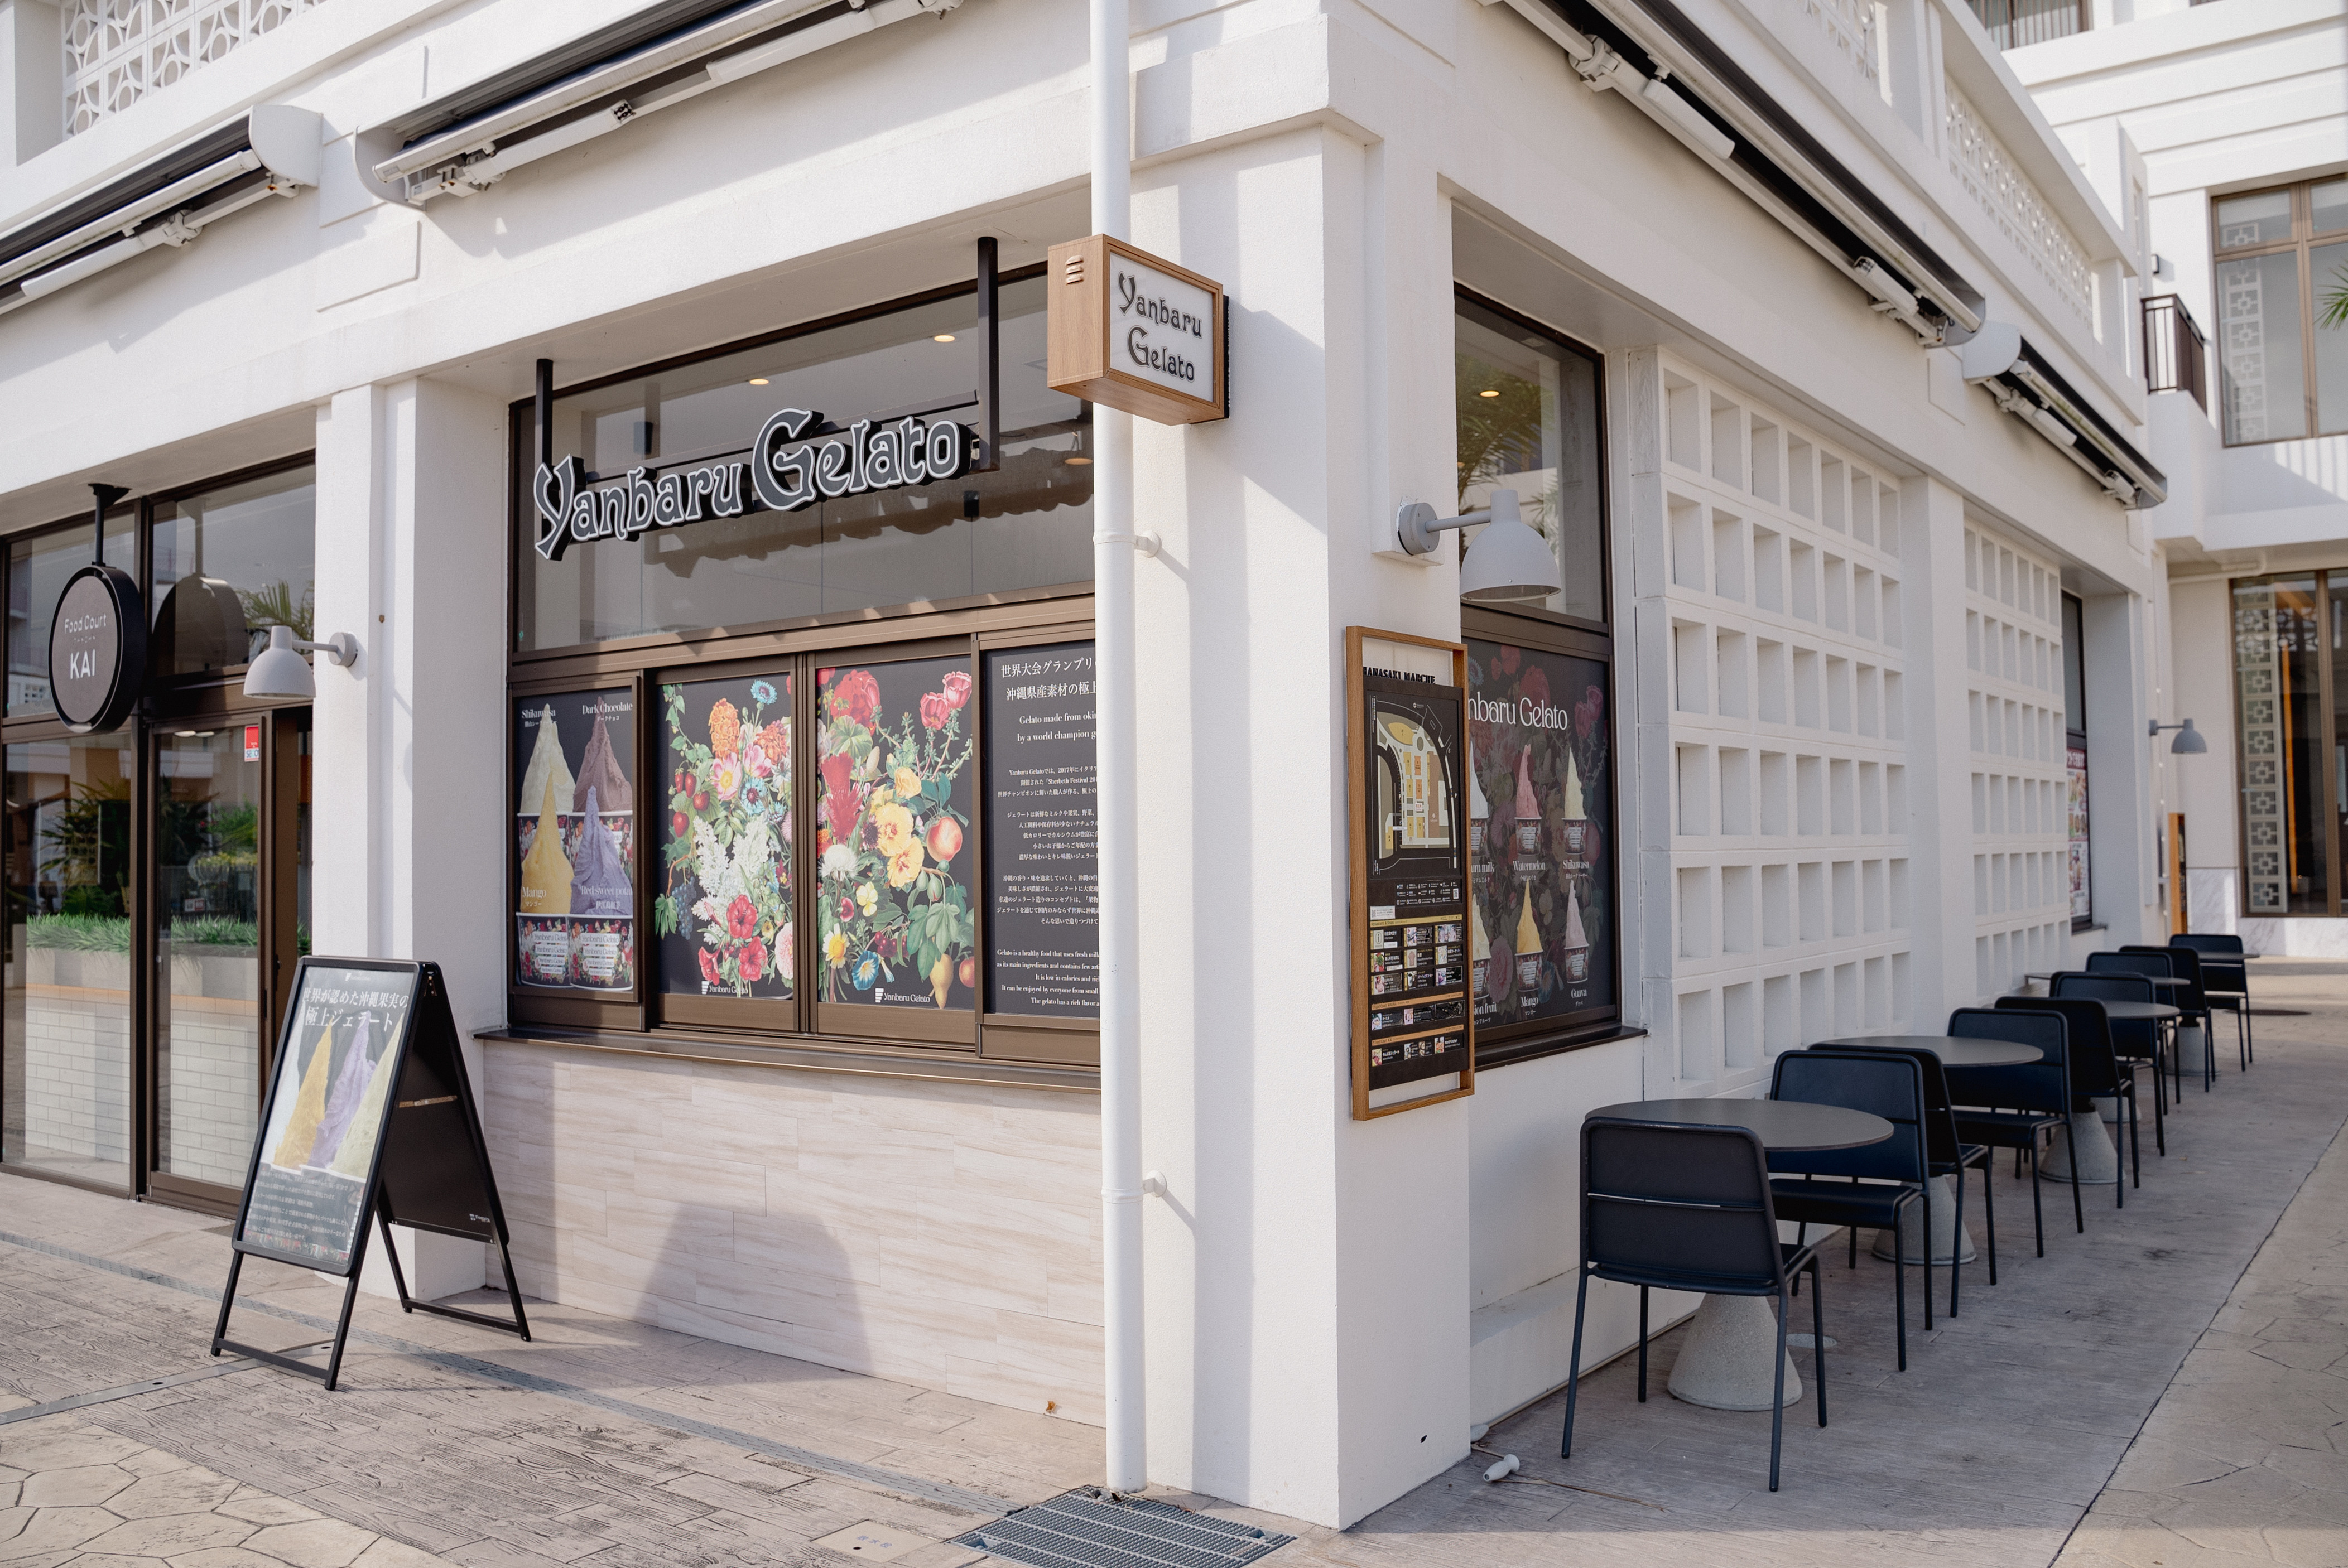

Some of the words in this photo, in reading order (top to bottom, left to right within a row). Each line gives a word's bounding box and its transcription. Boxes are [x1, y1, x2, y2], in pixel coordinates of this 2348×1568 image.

[1118, 271, 1202, 338] Yanbaru
[1127, 325, 1195, 382] Gelato
[533, 453, 744, 561] Yanbaru
[752, 407, 961, 511] Gelato
[65, 617, 83, 634] Food
[85, 614, 107, 630] Court
[70, 649, 95, 679] KAI
[1001, 657, 1096, 678] 世界大会グランプリ
[1404, 672, 1435, 684] MARCHE
[522, 709, 556, 719] Shikuwsa
[583, 705, 599, 715] Dark
[600, 702, 633, 712] Chocolate
[1519, 697, 1568, 730] Gelato
[1019, 715, 1042, 725] Gelato
[1043, 713, 1062, 723] made
[1064, 712, 1081, 722] from
[1017, 733, 1025, 744] by
[1033, 731, 1052, 741] world
[1054, 730, 1089, 741] champion
[1481, 862, 1495, 872] milk
[1513, 860, 1546, 871] Watermelon
[522, 887, 547, 898] Mango
[581, 885, 594, 895] Red
[884, 992, 910, 1001] Yanbaru
[910, 994, 931, 1003] Gelato
[1571, 988, 1587, 998] Guava
[1484, 1001, 1497, 1013] fruit
[1521, 997, 1538, 1008] Mango
[305, 1006, 393, 1031] 極上ジェラート
